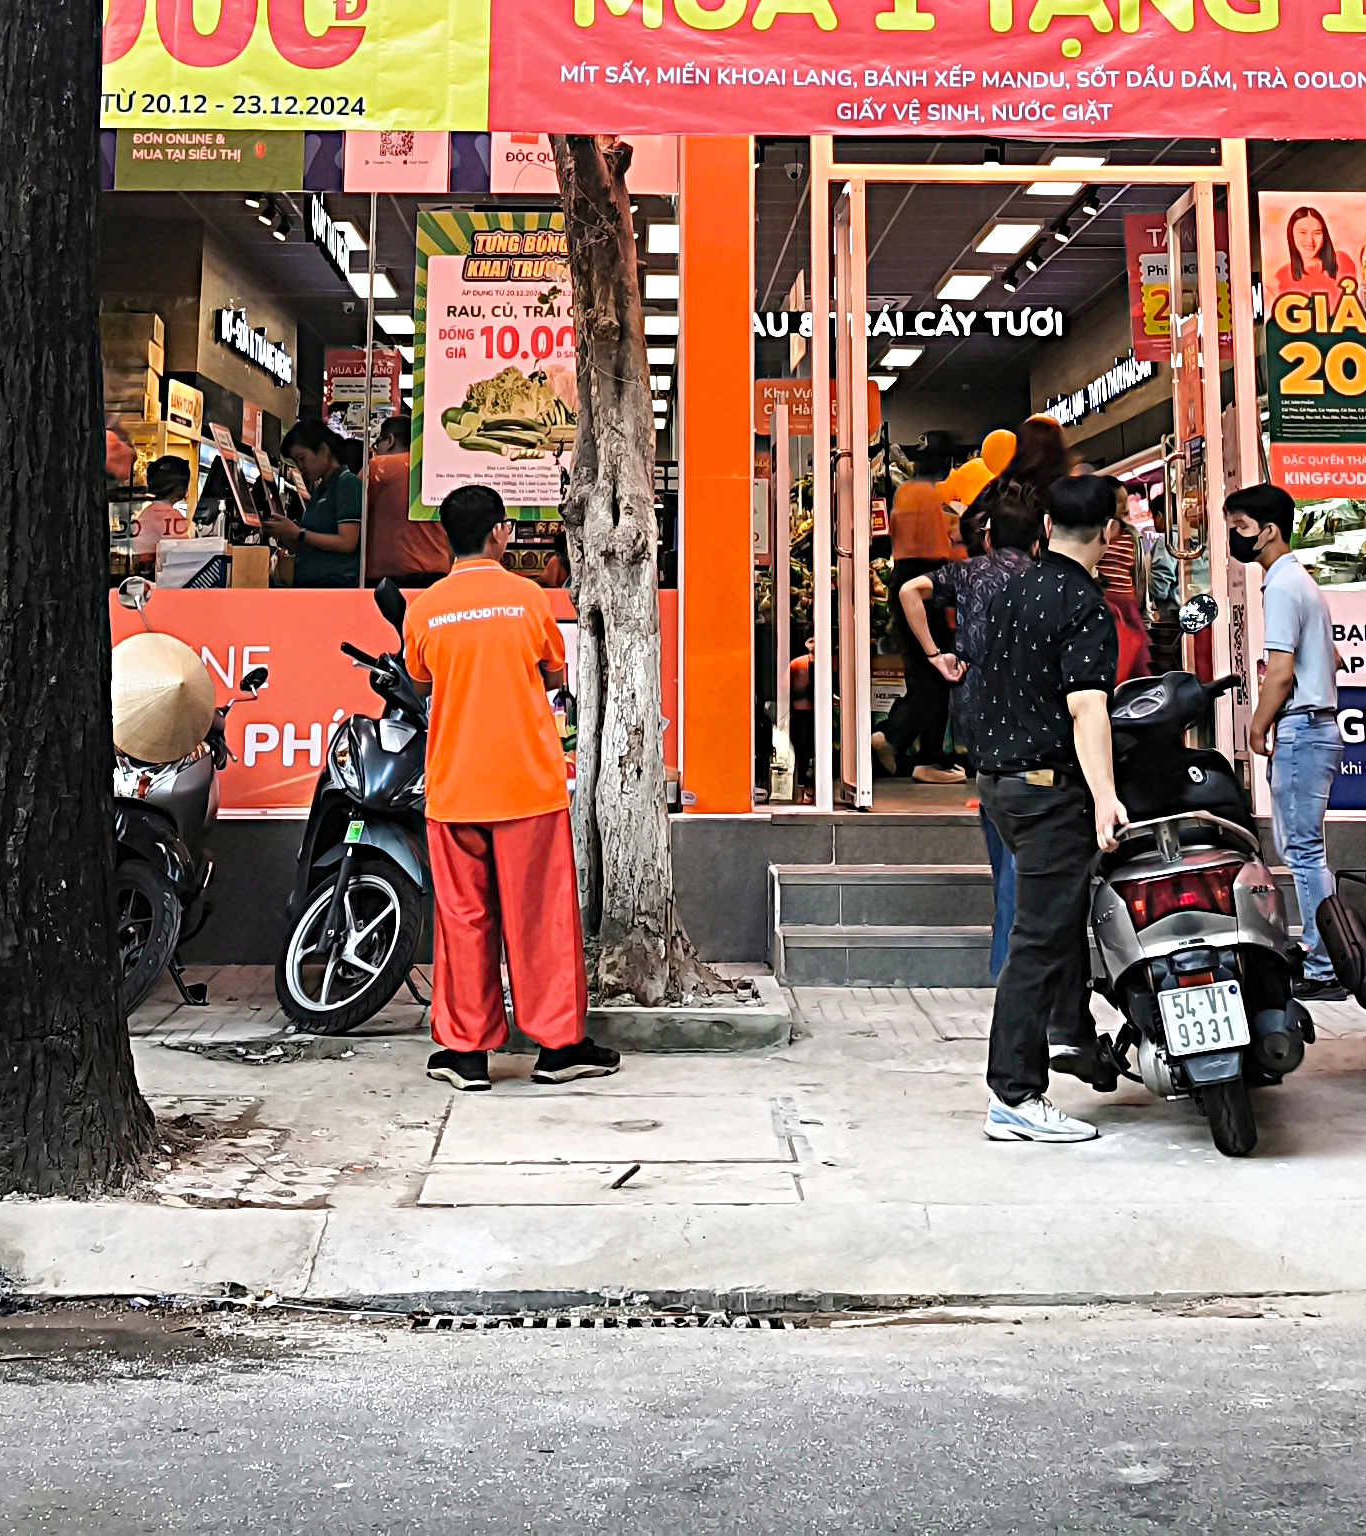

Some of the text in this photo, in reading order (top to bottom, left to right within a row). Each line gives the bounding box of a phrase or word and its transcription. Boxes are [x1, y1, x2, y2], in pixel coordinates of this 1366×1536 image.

[560, 61, 600, 83] MÍT
[604, 60, 650, 87] SẤY,
[717, 66, 786, 87] KHOAI
[793, 69, 858, 90] LANG,
[863, 65, 928, 88] BÁNH
[934, 64, 976, 89] XẾP
[981, 70, 1071, 91] MANDU,
[1075, 64, 1120, 89] SỐT
[1125, 63, 1175, 89] DẦU
[1180, 63, 1237, 91] DẤM,
[1242, 66, 1287, 90] TRÀ
[141, 93, 208, 114] 20.12
[232, 94, 366, 116] 23.12.2024
[836, 96, 1113, 125] GIẤY VỆ SINH, NƯỚC GIẶT
[132, 130, 226, 145] ĐƠN ONLINE &
[132, 144, 242, 163] MUA TẠI SIÊU THỊ
[505, 147, 534, 166] ĐỘC
[466, 258, 510, 278] KHAI
[447, 301, 518, 320] RAU, CỦ,
[914, 303, 977, 338] CÂY
[984, 306, 1063, 338] TƯƠI
[445, 344, 467, 359] GIÁ
[330, 366, 351, 375] MUA
[1282, 454, 1307, 467] ĐẶC
[1308, 452, 1345, 466] QUYỀN
[1341, 761, 1362, 775] khi
[1172, 988, 1228, 1019] 54-V1
[1178, 1016, 1234, 1048] 9331
